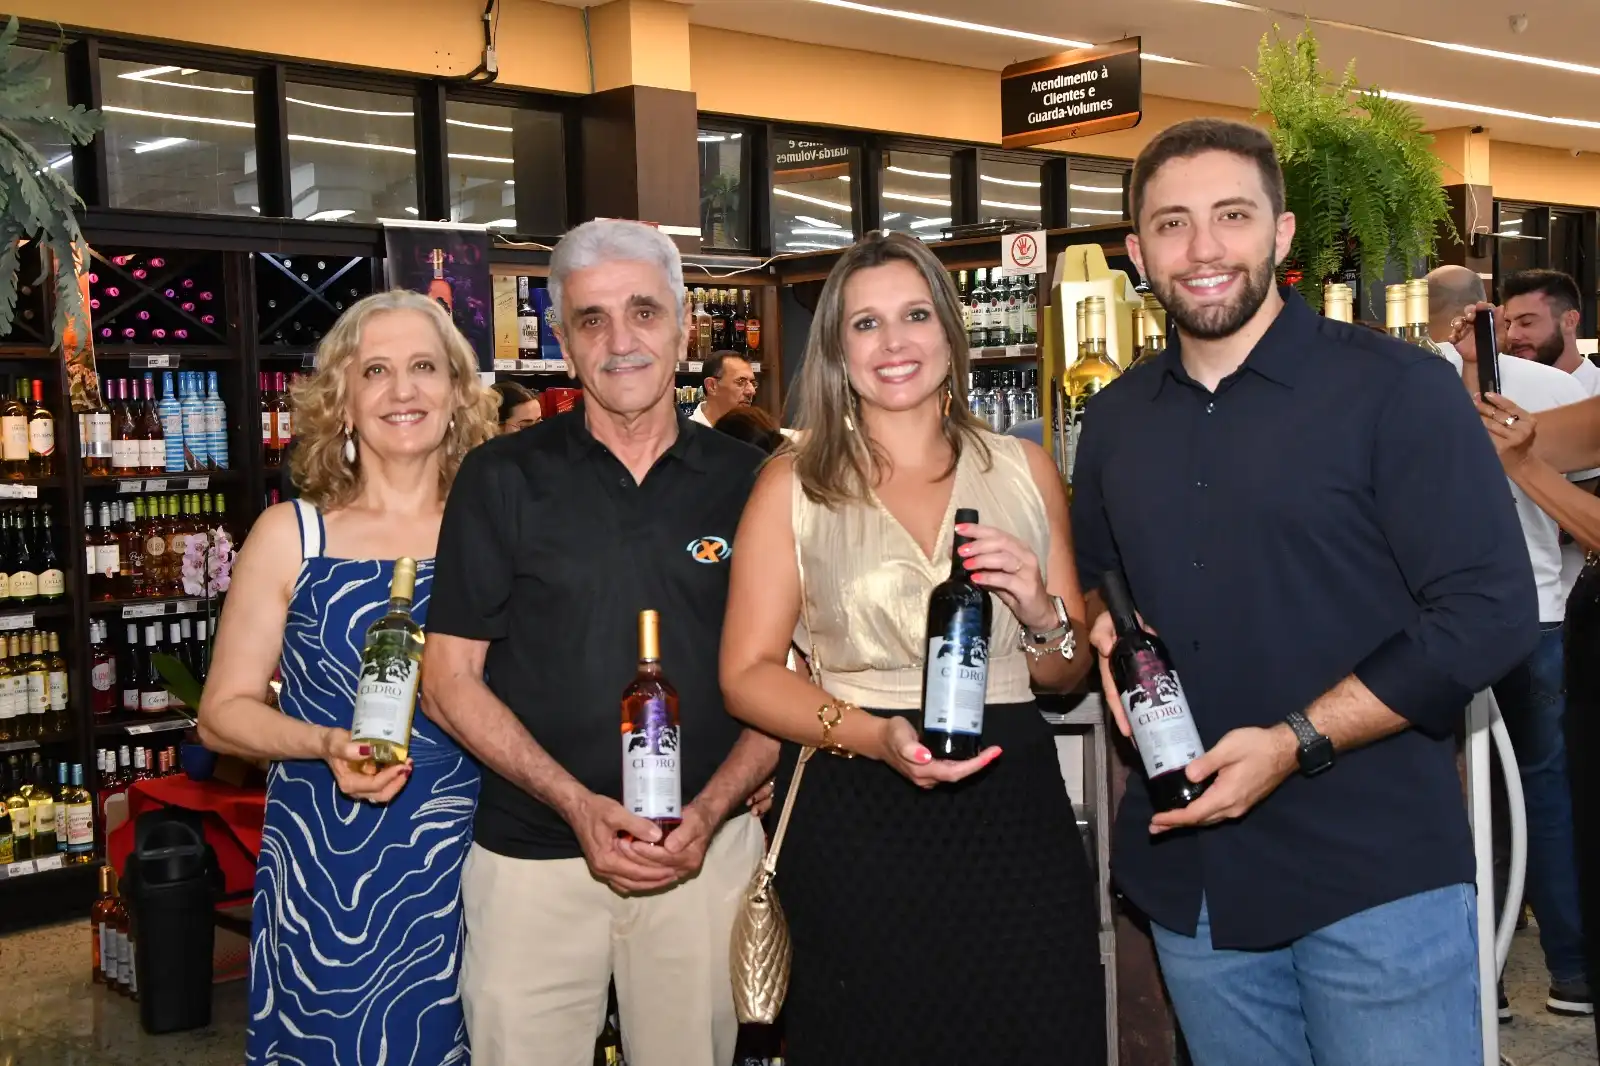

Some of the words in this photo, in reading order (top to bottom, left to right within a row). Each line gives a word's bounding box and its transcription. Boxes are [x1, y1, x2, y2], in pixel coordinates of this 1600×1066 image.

[1030, 68, 1098, 93] Atendimento
[1101, 65, 1109, 79] à
[1043, 88, 1086, 106] Clientes
[1088, 86, 1096, 97] e
[1027, 98, 1113, 124] Guarda-Volumes
[941, 667, 985, 681] CDRO
[1138, 703, 1183, 726] CEDRO
[632, 759, 676, 769] CERO
